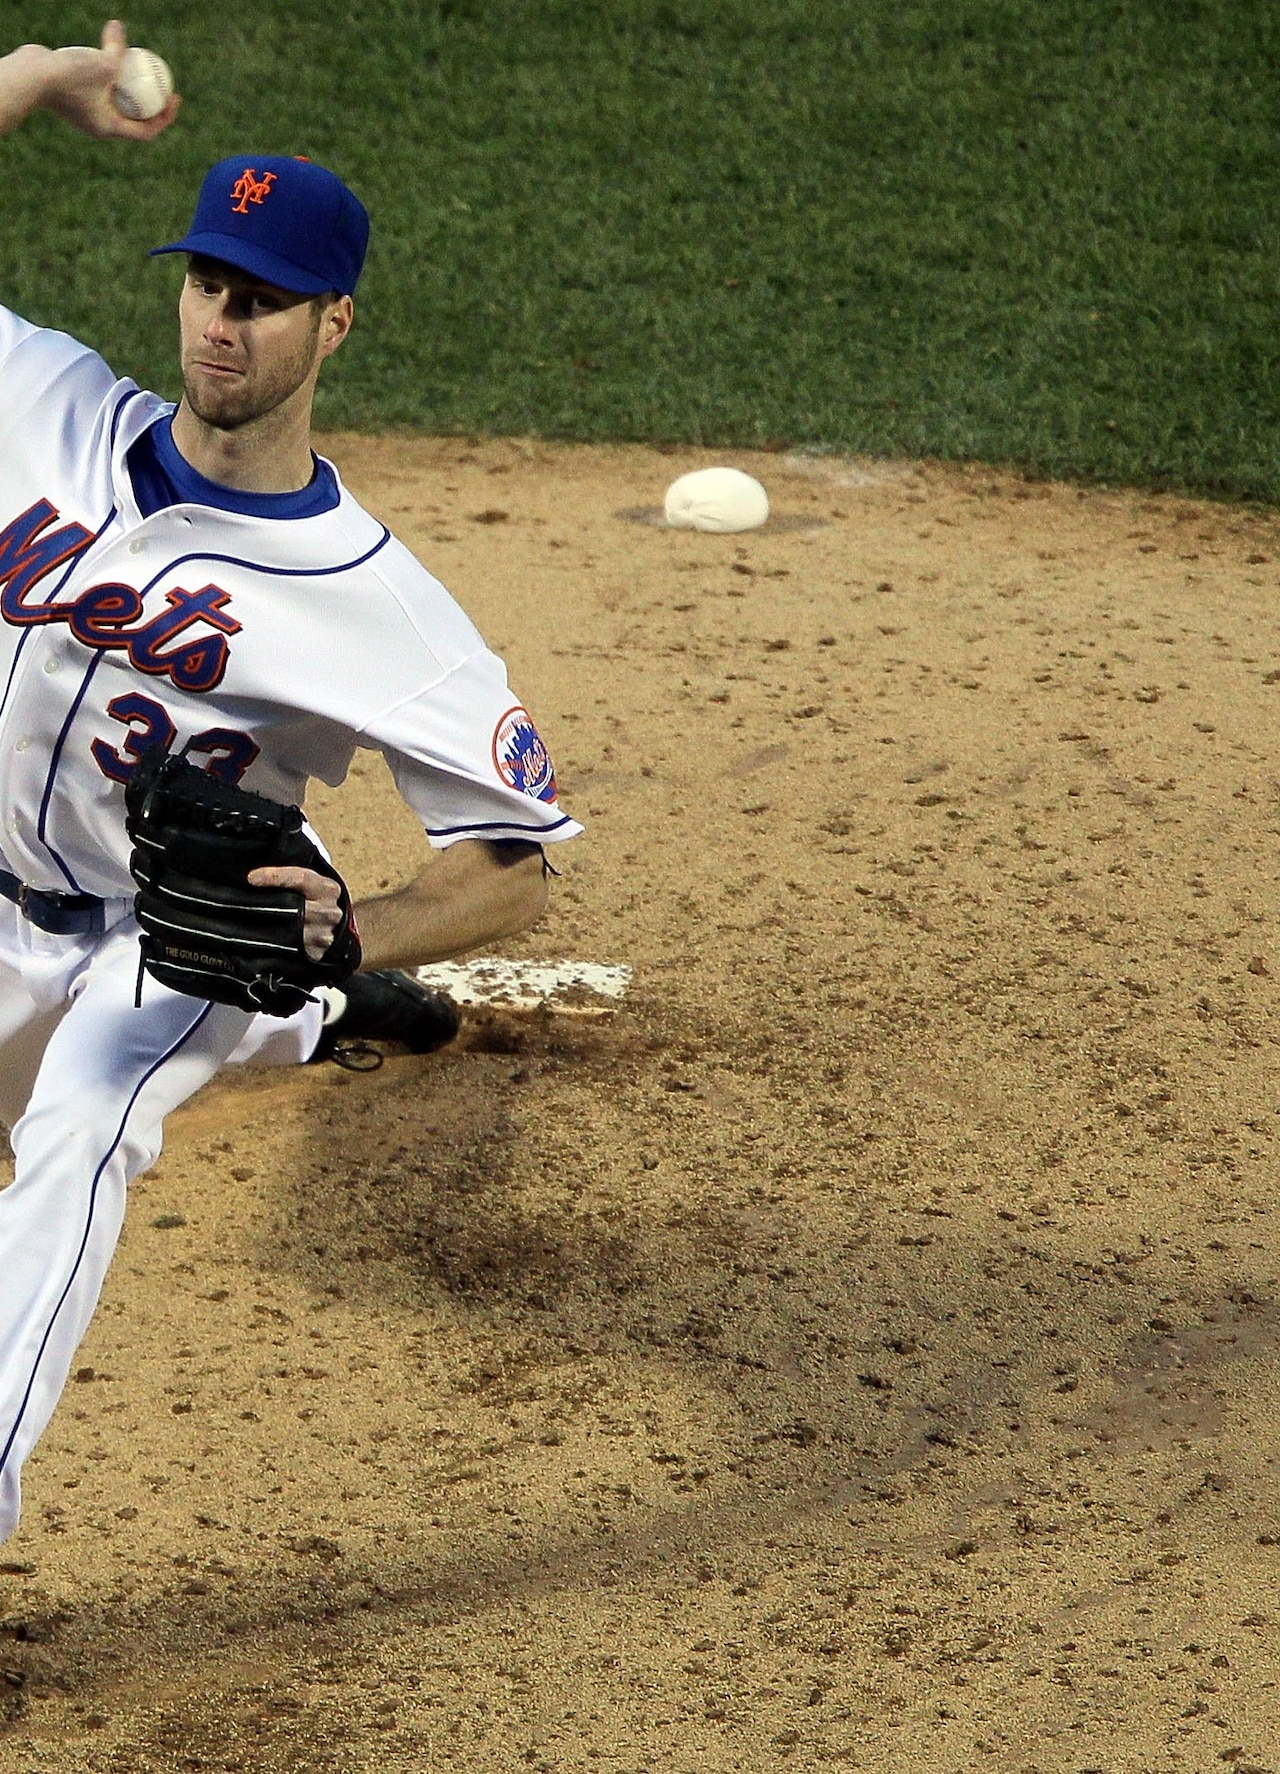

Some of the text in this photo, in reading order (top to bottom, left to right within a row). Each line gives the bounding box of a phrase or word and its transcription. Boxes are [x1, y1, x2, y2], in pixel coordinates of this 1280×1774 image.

[230, 168, 277, 213] NY
[90, 691, 261, 787] 33
[165, 946, 179, 957] THE
[180, 949, 199, 961] GOLD
[200, 954, 223, 968] GLOVE
